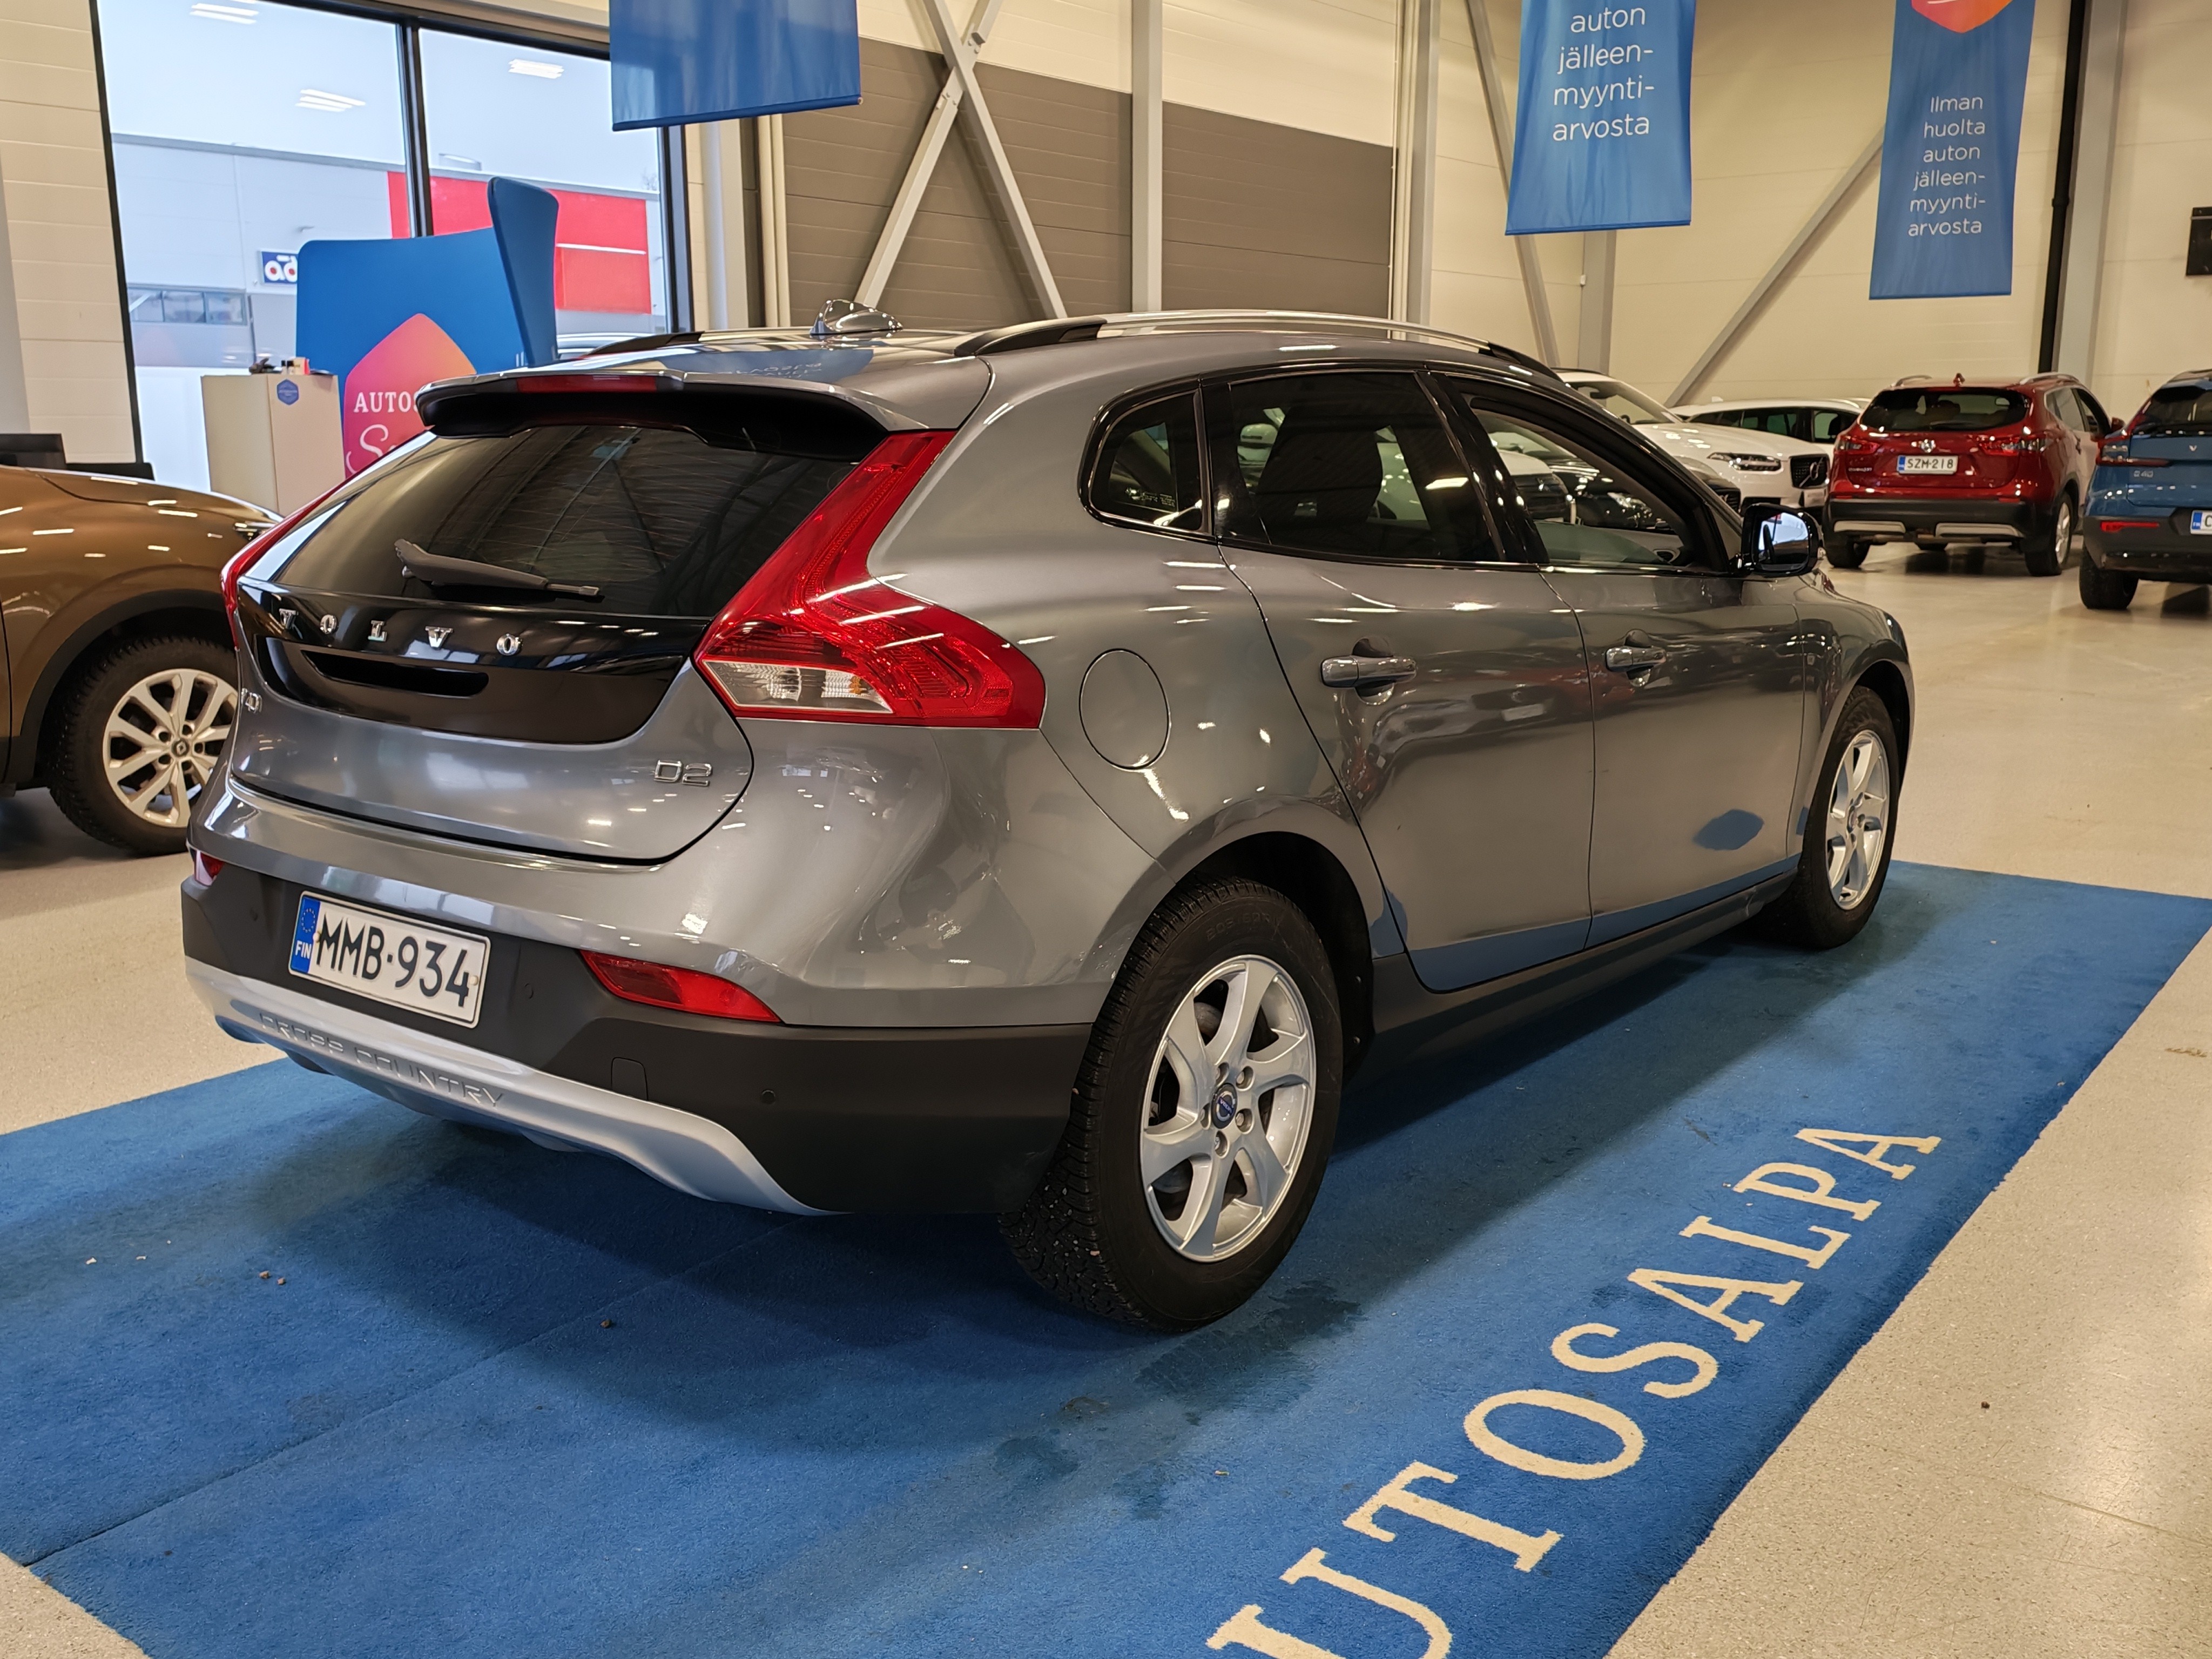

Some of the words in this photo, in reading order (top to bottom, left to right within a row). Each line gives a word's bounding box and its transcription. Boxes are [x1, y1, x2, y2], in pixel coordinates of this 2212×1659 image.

[1570, 7, 1645, 33] auton
[1557, 44, 1654, 75] jälleen-
[1554, 75, 1655, 109] myynti-
[1931, 96, 1983, 113] Ilman
[1553, 114, 1650, 141] arvosta
[1924, 118, 1985, 138] huolta
[1923, 145, 1980, 163] auton
[1913, 170, 1986, 191] jälleen-
[1910, 192, 1986, 214] myynti-
[1908, 218, 1982, 237] arvosta
[1907, 458, 1954, 469] SZM-218
[279, 608, 523, 656] VOLVO
[653, 760, 712, 787] D2
[295, 940, 312, 959] FIN
[316, 911, 470, 1008] MMB-934
[260, 1013, 344, 1053] CROSS
[354, 1047, 503, 1108] COUNTRY
